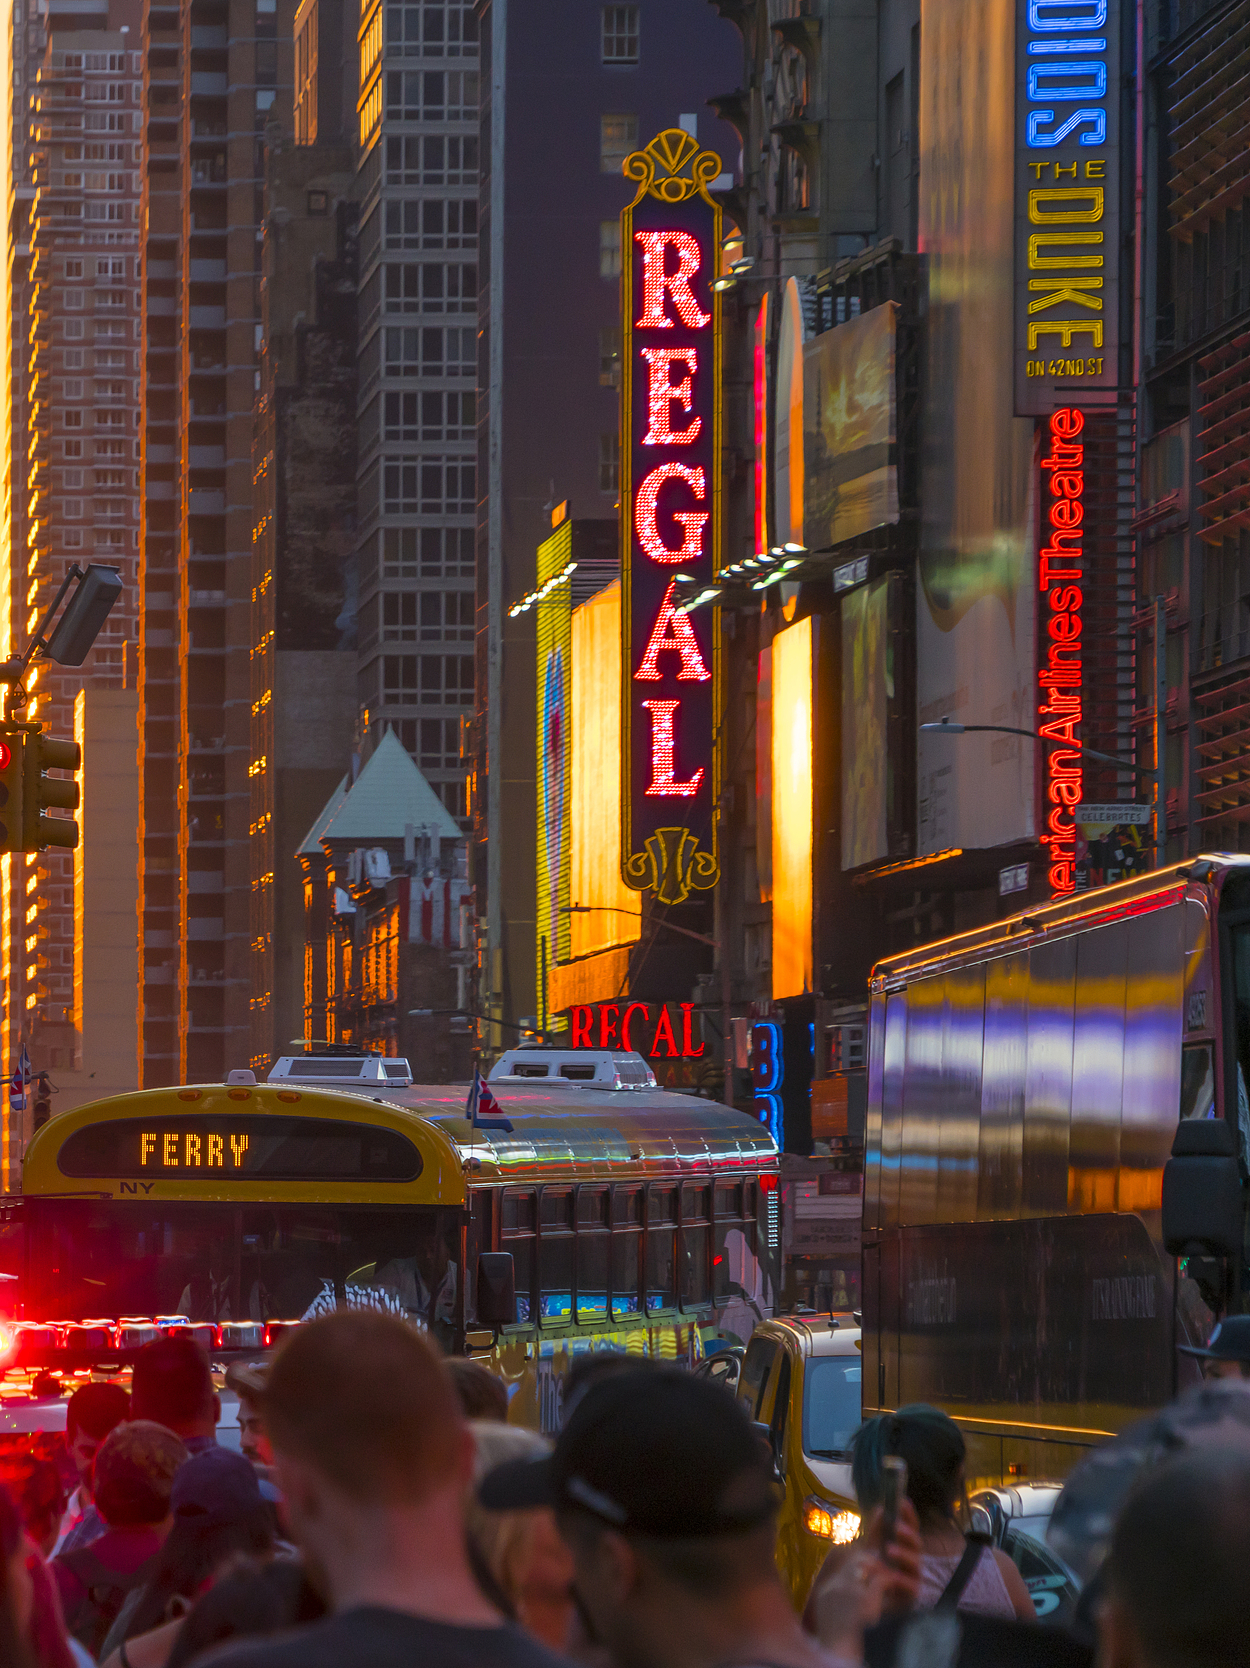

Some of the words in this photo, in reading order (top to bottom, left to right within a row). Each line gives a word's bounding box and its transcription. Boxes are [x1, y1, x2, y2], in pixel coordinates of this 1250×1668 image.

[1028, 160, 1106, 180] THE
[1027, 186, 1104, 351] DUKE
[1026, 360, 1045, 377] ON
[1048, 358, 1084, 377] 42ND
[1087, 357, 1104, 375] ST
[1039, 407, 1085, 591] Theatre
[633, 230, 711, 798] REGAL
[1081, 812, 1141, 822] CELEBRATES
[141, 1133, 249, 1167] FERRY
[119, 1181, 155, 1194] NY
